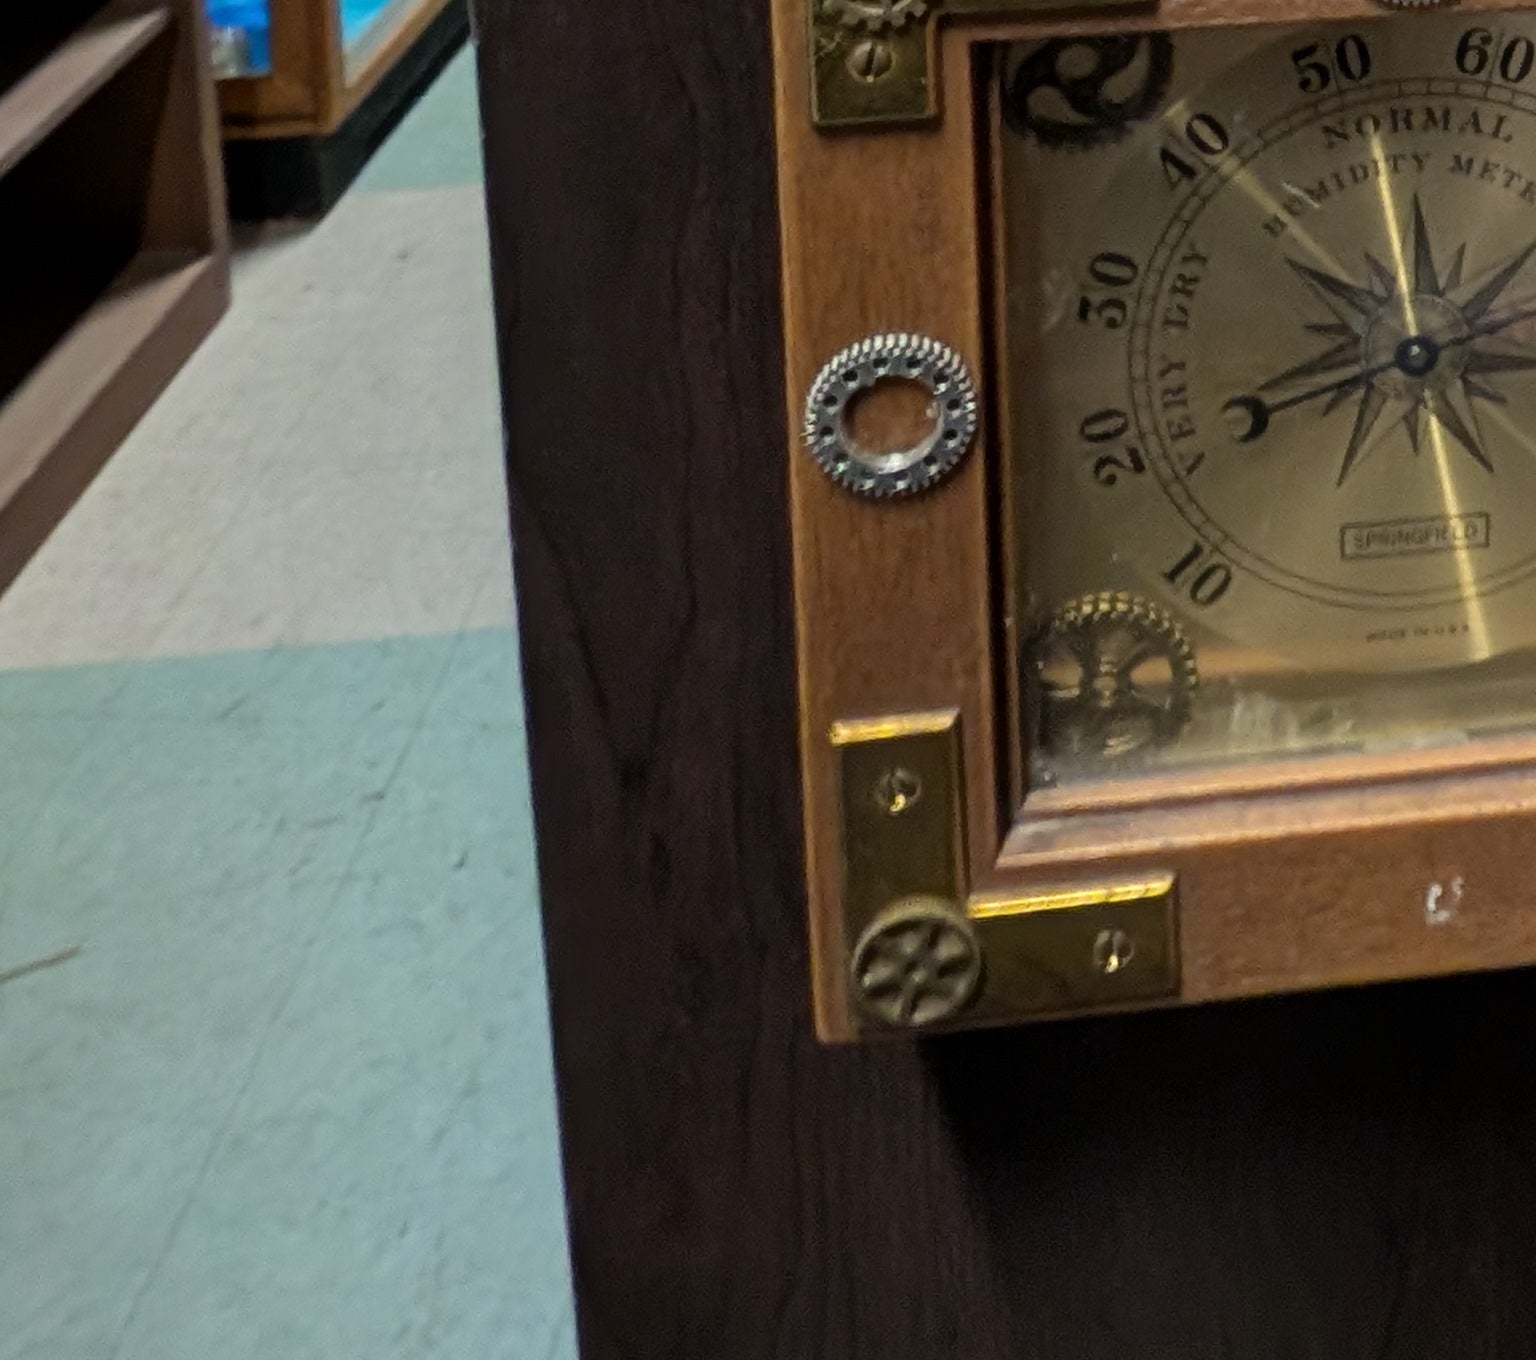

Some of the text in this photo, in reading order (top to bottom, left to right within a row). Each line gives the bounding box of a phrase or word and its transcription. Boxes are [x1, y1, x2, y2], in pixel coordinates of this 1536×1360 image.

[1292, 34, 1372, 93] 50
[1455, 27, 1536, 84] 60
[1159, 113, 1230, 189] 40
[1321, 106, 1514, 150] NORMAL
[1076, 252, 1139, 330] 30
[1158, 243, 1209, 476] VERY DRY
[1078, 408, 1147, 487] 20
[1162, 541, 1233, 608] 10
